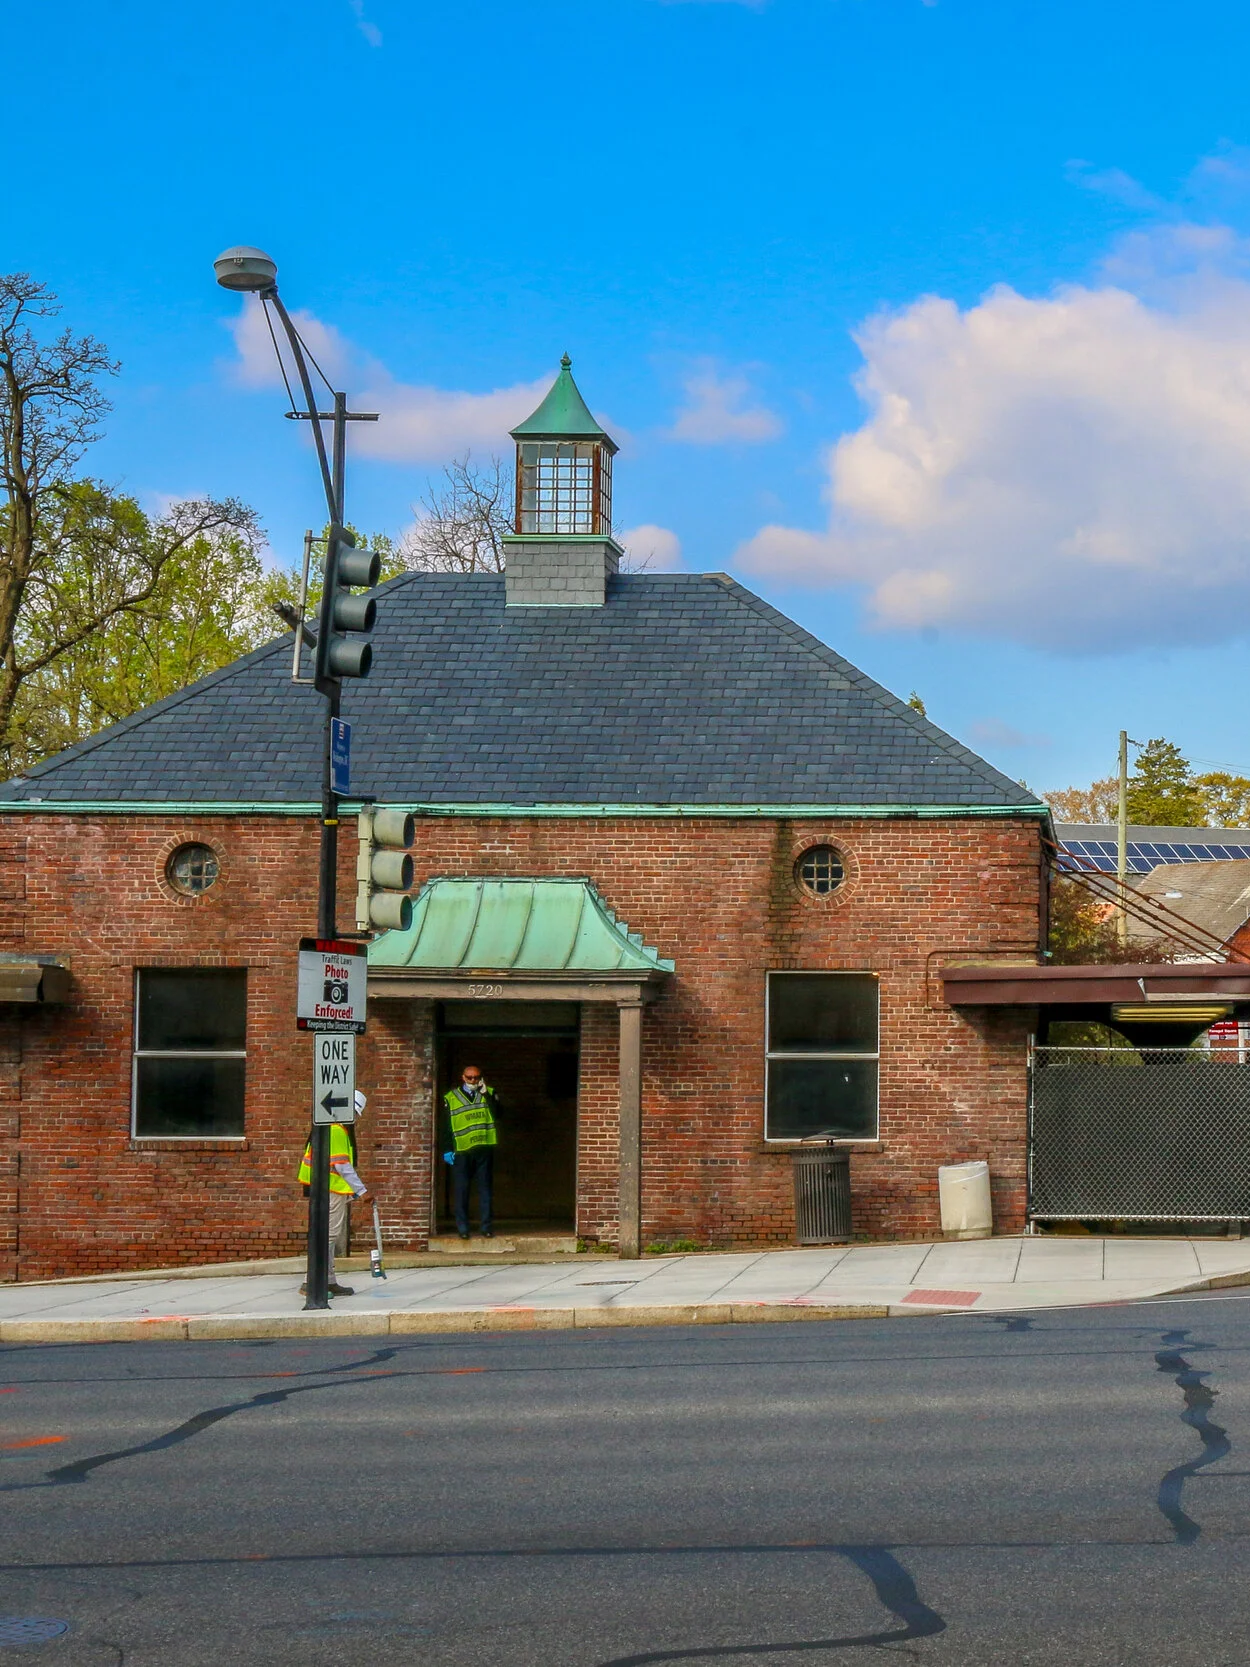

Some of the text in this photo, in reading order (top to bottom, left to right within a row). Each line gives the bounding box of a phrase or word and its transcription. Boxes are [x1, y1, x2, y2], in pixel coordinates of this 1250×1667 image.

[322, 954, 353, 966] Traffic Laws
[325, 964, 349, 979] Photo
[468, 984, 503, 996] 5720
[315, 1003, 354, 1020] Enforced!
[307, 1019, 327, 1031] Keeping
[327, 1020, 335, 1029] the
[335, 1022, 349, 1030] District
[321, 1040, 349, 1061] ONE
[320, 1064, 350, 1085] WAY
